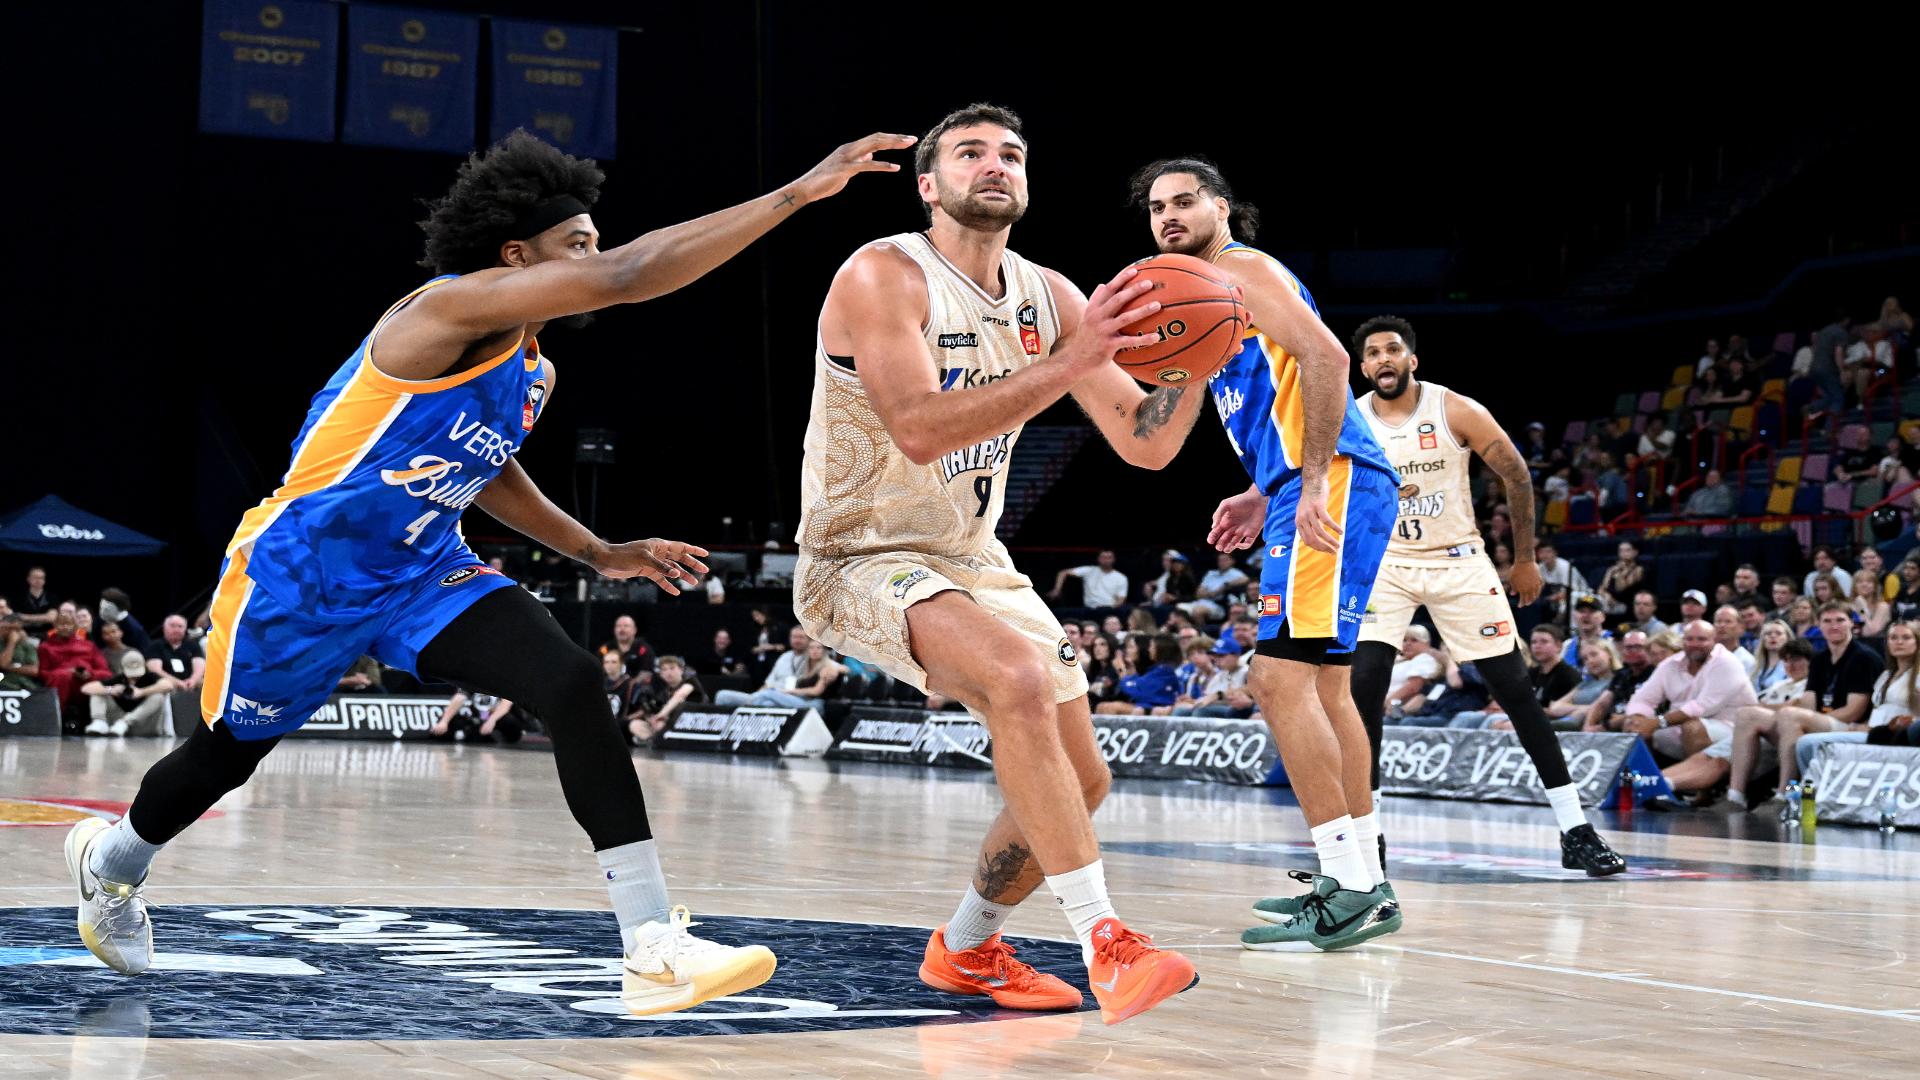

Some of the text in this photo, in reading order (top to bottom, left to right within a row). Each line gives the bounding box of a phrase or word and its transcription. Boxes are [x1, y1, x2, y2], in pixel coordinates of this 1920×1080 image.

[982, 315, 1009, 327] OPTUS
[940, 334, 978, 347] myfield
[448, 411, 520, 467] VERS
[1394, 459, 1446, 476] nfrost
[973, 476, 993, 517] 9
[1396, 490, 1444, 519] PANS
[404, 510, 441, 546] 4
[1398, 519, 1422, 540] 43
[1159, 730, 1267, 770] VERSO.
